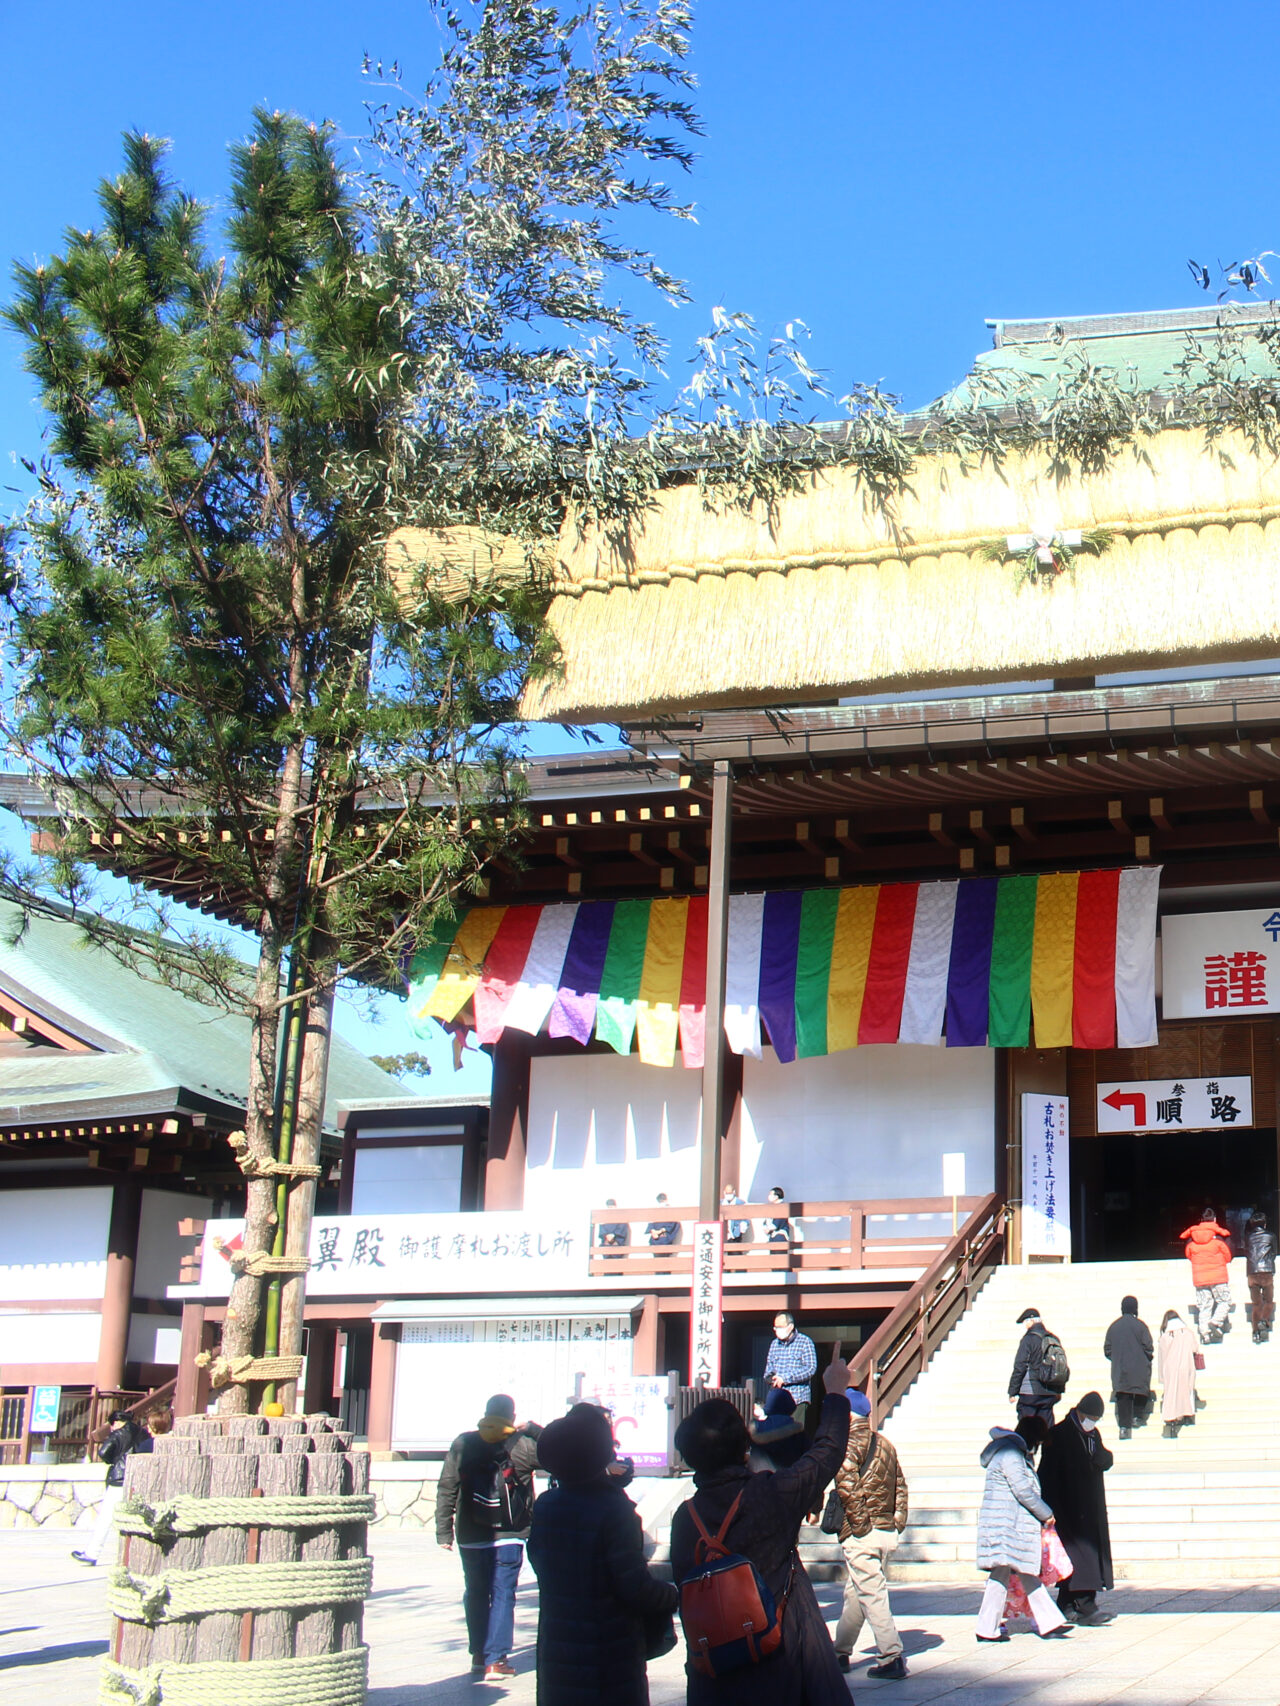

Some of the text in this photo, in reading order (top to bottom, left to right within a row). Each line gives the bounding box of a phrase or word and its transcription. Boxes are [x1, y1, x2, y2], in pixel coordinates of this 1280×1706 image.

[1171, 1082, 1219, 1096] 参詣
[1156, 1095, 1241, 1123] 順路
[399, 1230, 574, 1260] 御護摩札お渡し所
[697, 1229, 713, 1384] 交通安全御札所入口
